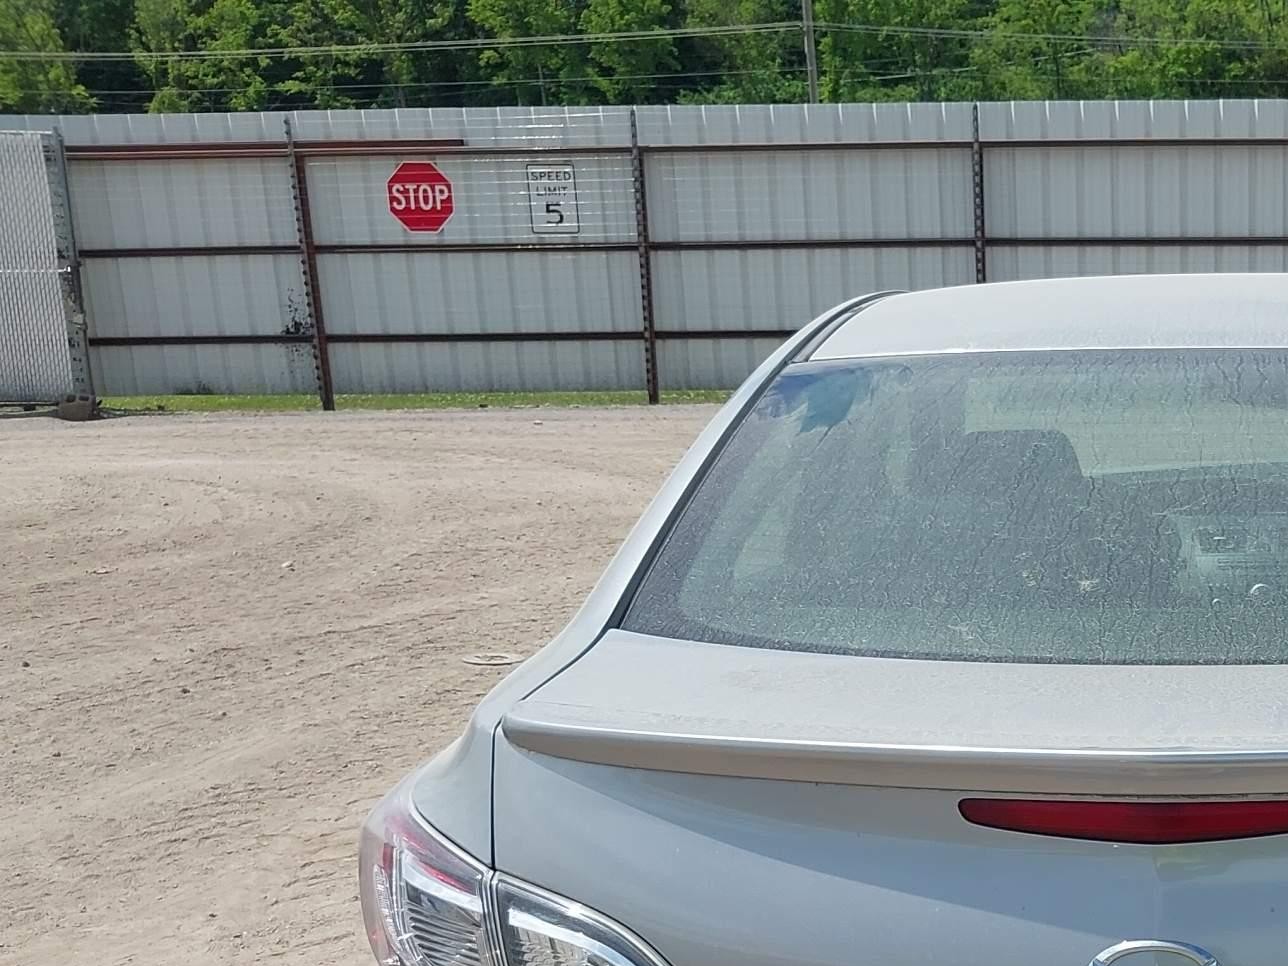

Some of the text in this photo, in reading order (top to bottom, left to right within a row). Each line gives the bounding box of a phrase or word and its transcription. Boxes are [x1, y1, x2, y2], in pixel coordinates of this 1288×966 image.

[530, 170, 572, 181] SPEED
[391, 183, 450, 211] STOP
[536, 185, 568, 196] LIMIT
[544, 203, 564, 225] 5
